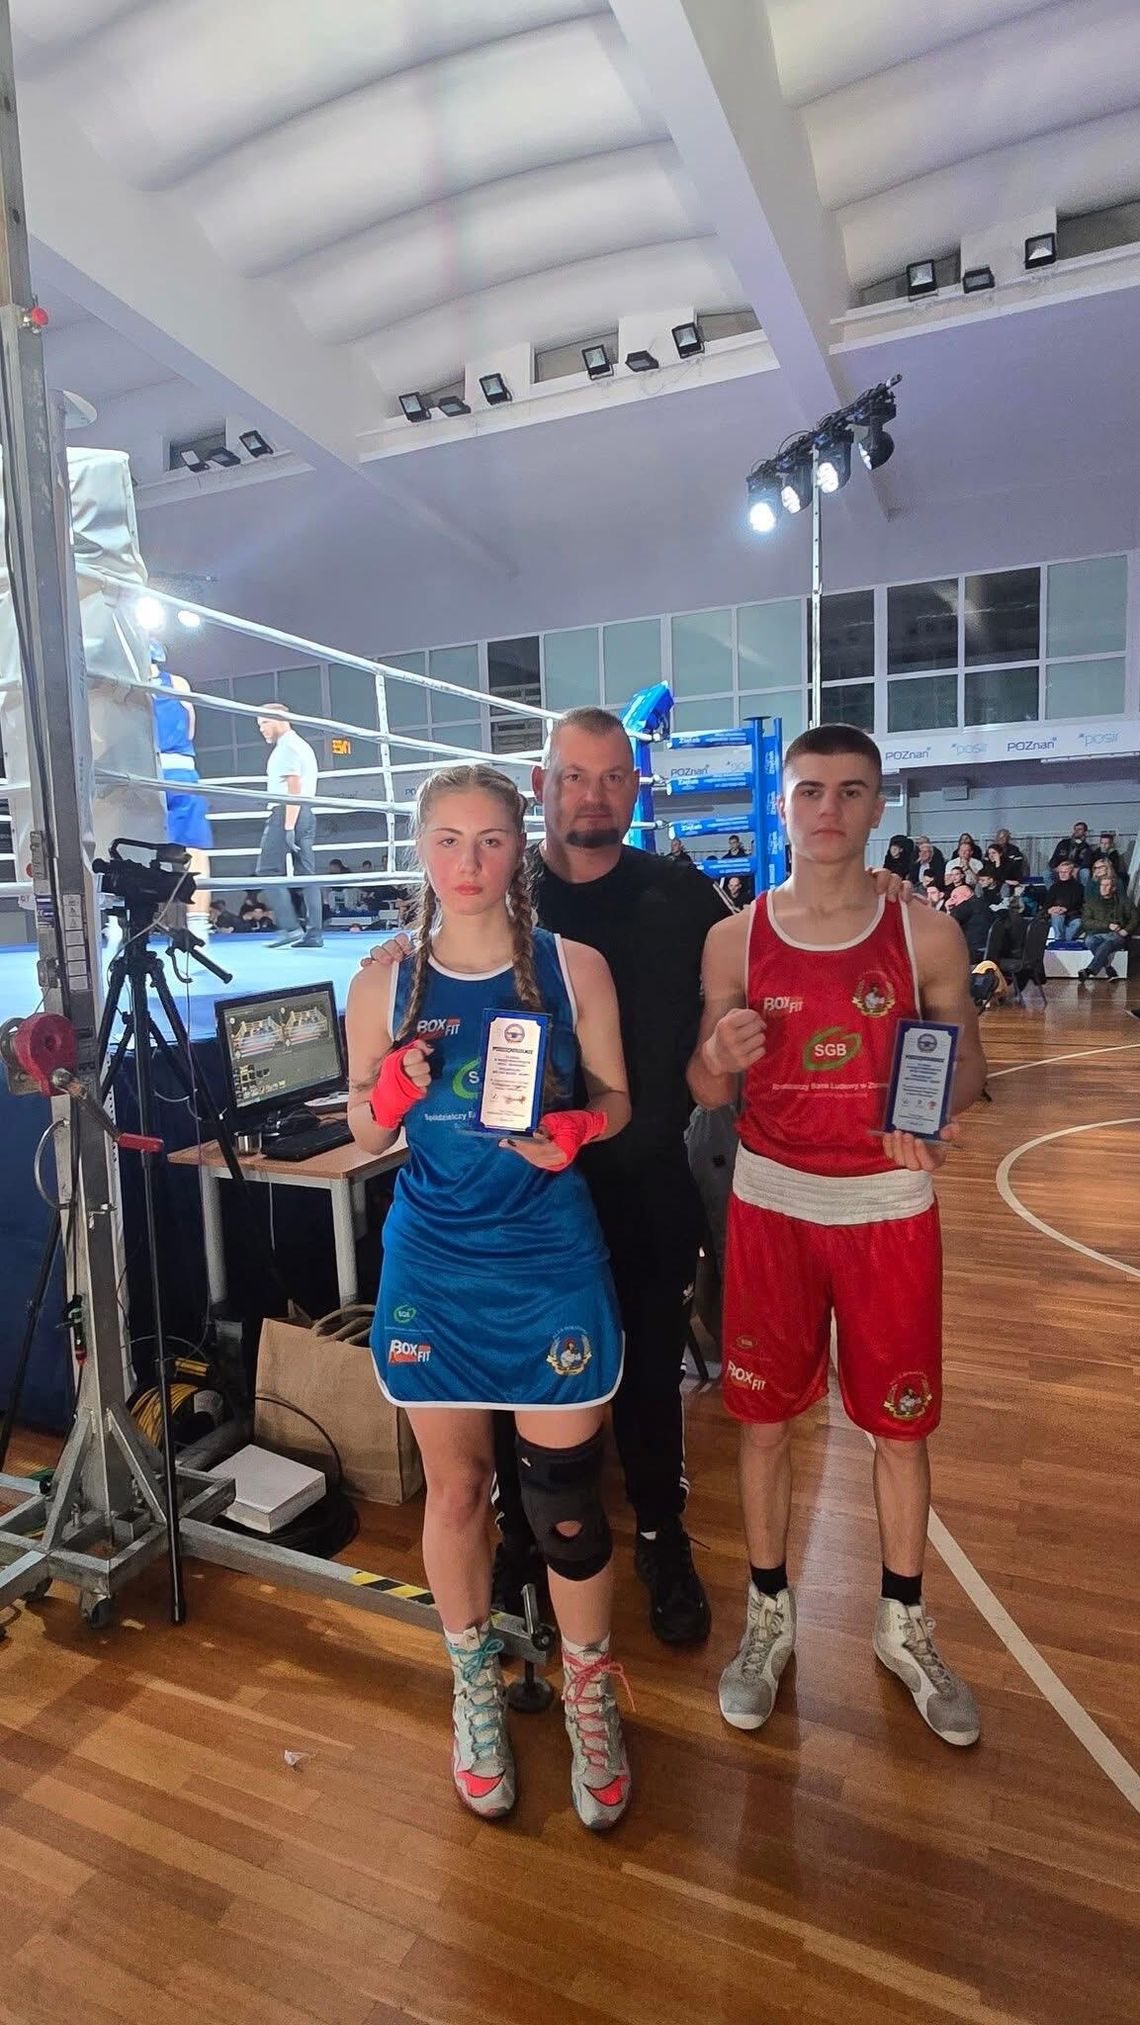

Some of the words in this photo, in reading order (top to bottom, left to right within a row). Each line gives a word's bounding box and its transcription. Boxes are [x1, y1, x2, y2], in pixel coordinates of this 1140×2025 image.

[763, 996, 790, 1011] BOX
[417, 1018, 447, 1034] BOX
[445, 1023, 461, 1036] FIT
[814, 1043, 847, 1056] SGB
[388, 1339, 418, 1361] BOX
[417, 1350, 432, 1363] FIT
[727, 1359, 754, 1384] BOX
[751, 1379, 767, 1390] FIT
